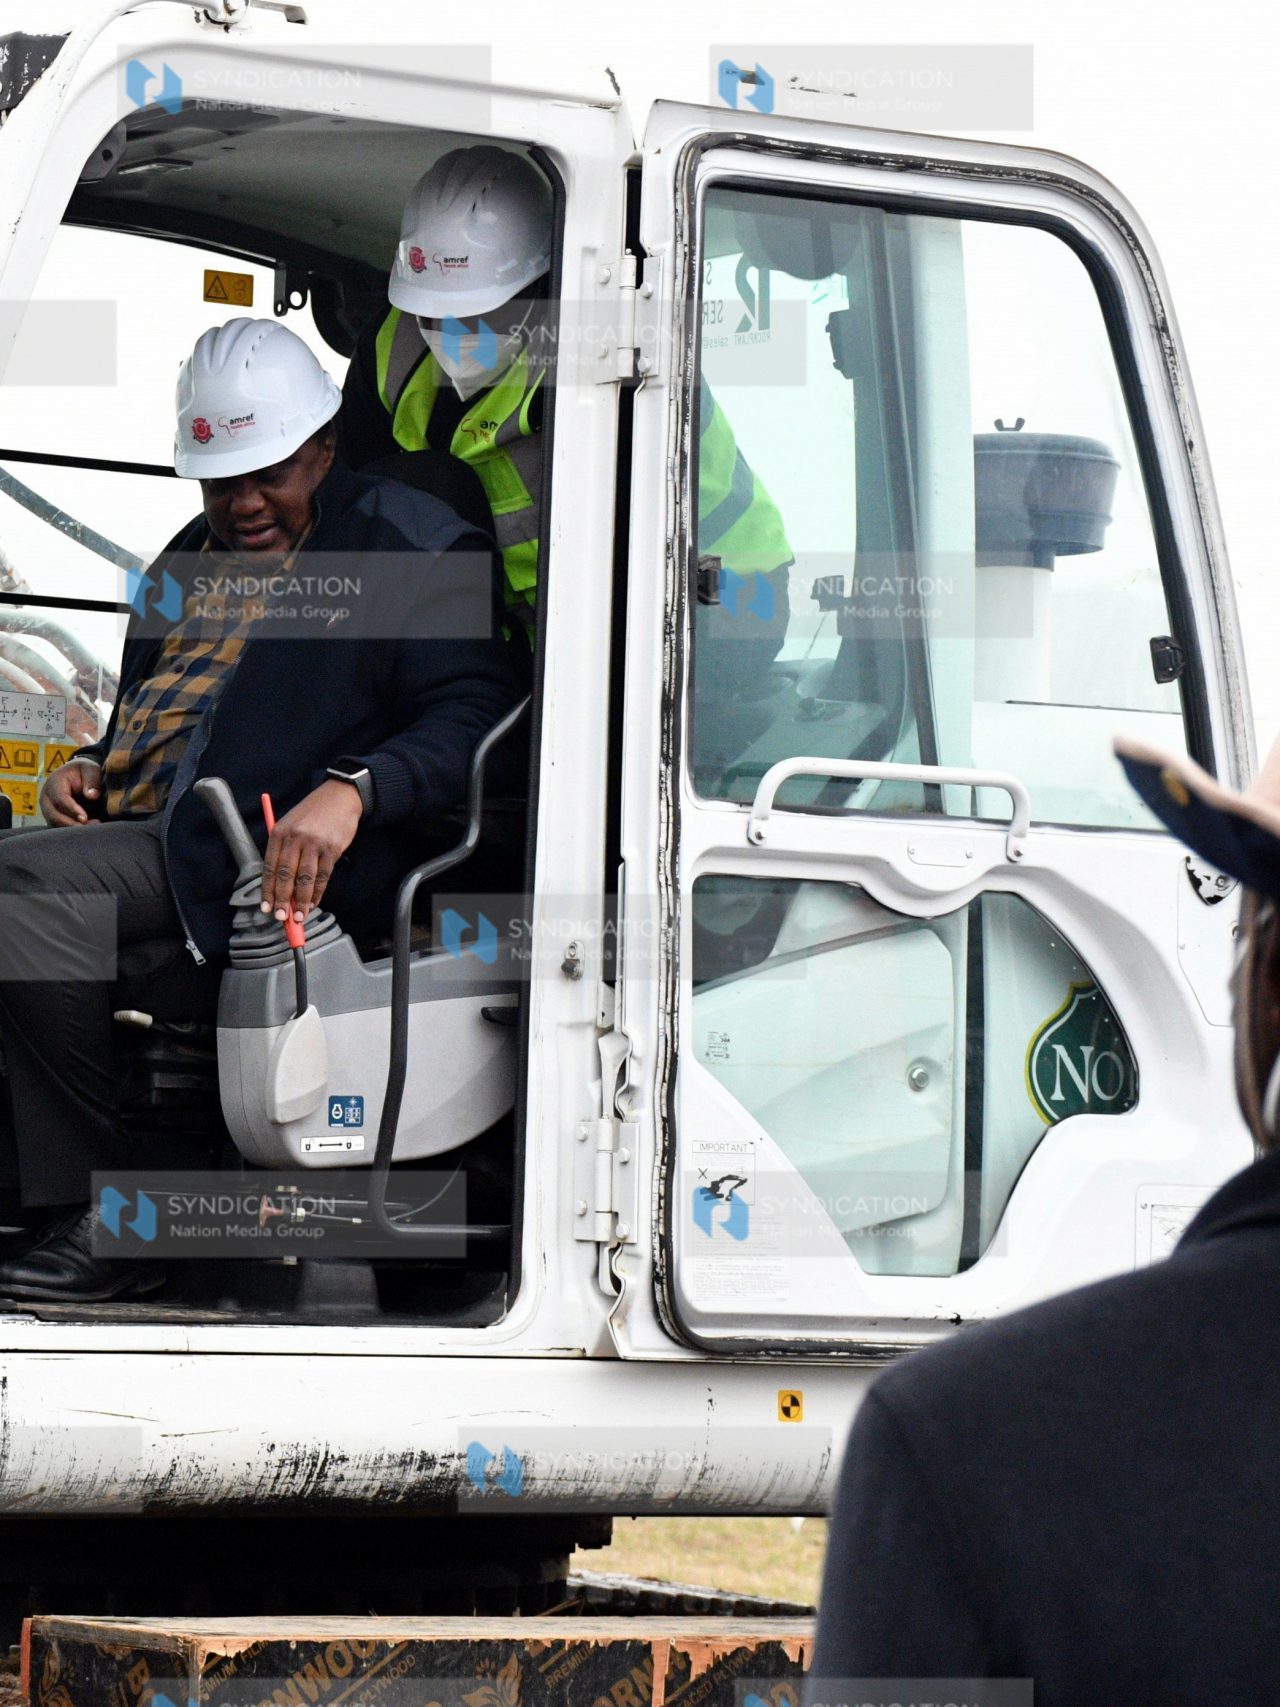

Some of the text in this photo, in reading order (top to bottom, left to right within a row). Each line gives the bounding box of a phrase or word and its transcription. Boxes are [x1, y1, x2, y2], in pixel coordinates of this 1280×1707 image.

[443, 256, 469, 264] amref
[229, 413, 254, 425] amref
[699, 1143, 749, 1153] IMPORTANT
